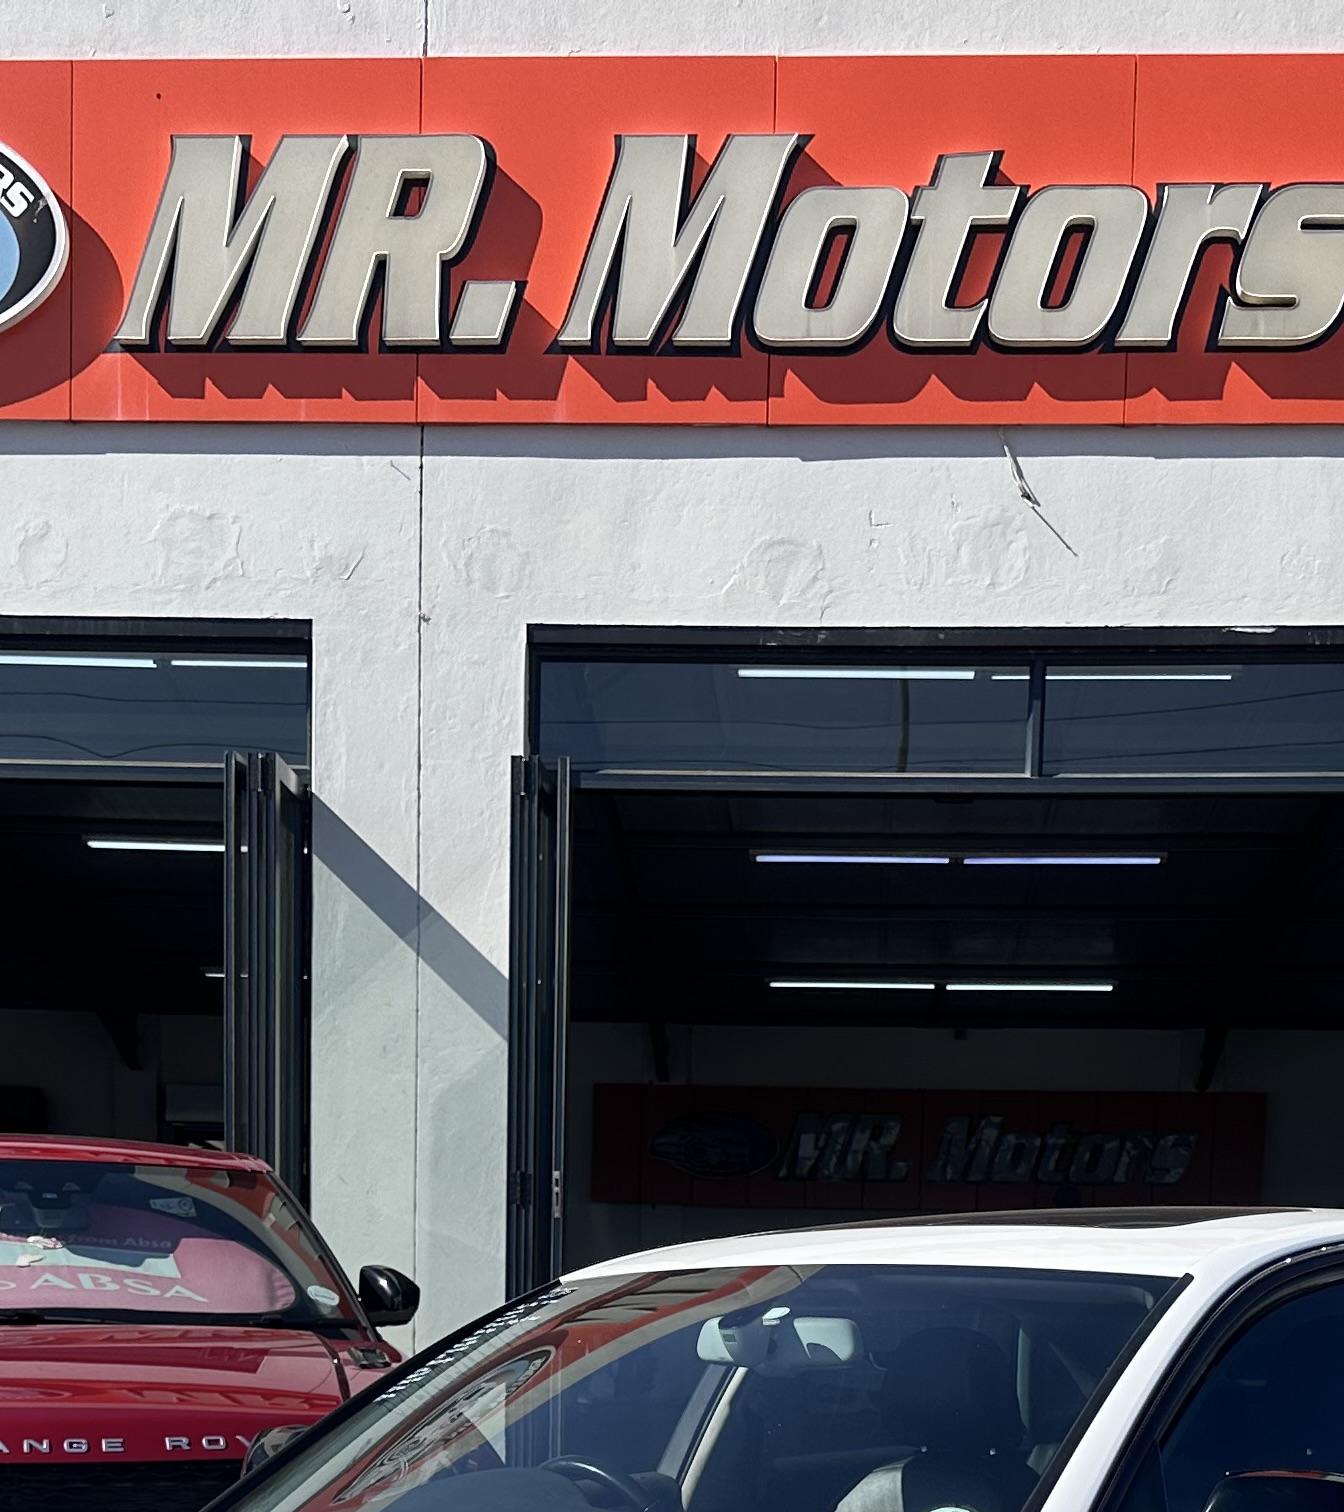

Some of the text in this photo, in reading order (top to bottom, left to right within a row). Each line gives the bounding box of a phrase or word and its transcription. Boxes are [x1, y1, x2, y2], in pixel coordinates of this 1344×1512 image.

[116, 132, 528, 350] MR.
[778, 1111, 1199, 1185] MR. Motors
[30, 1272, 209, 1303] ABSA
